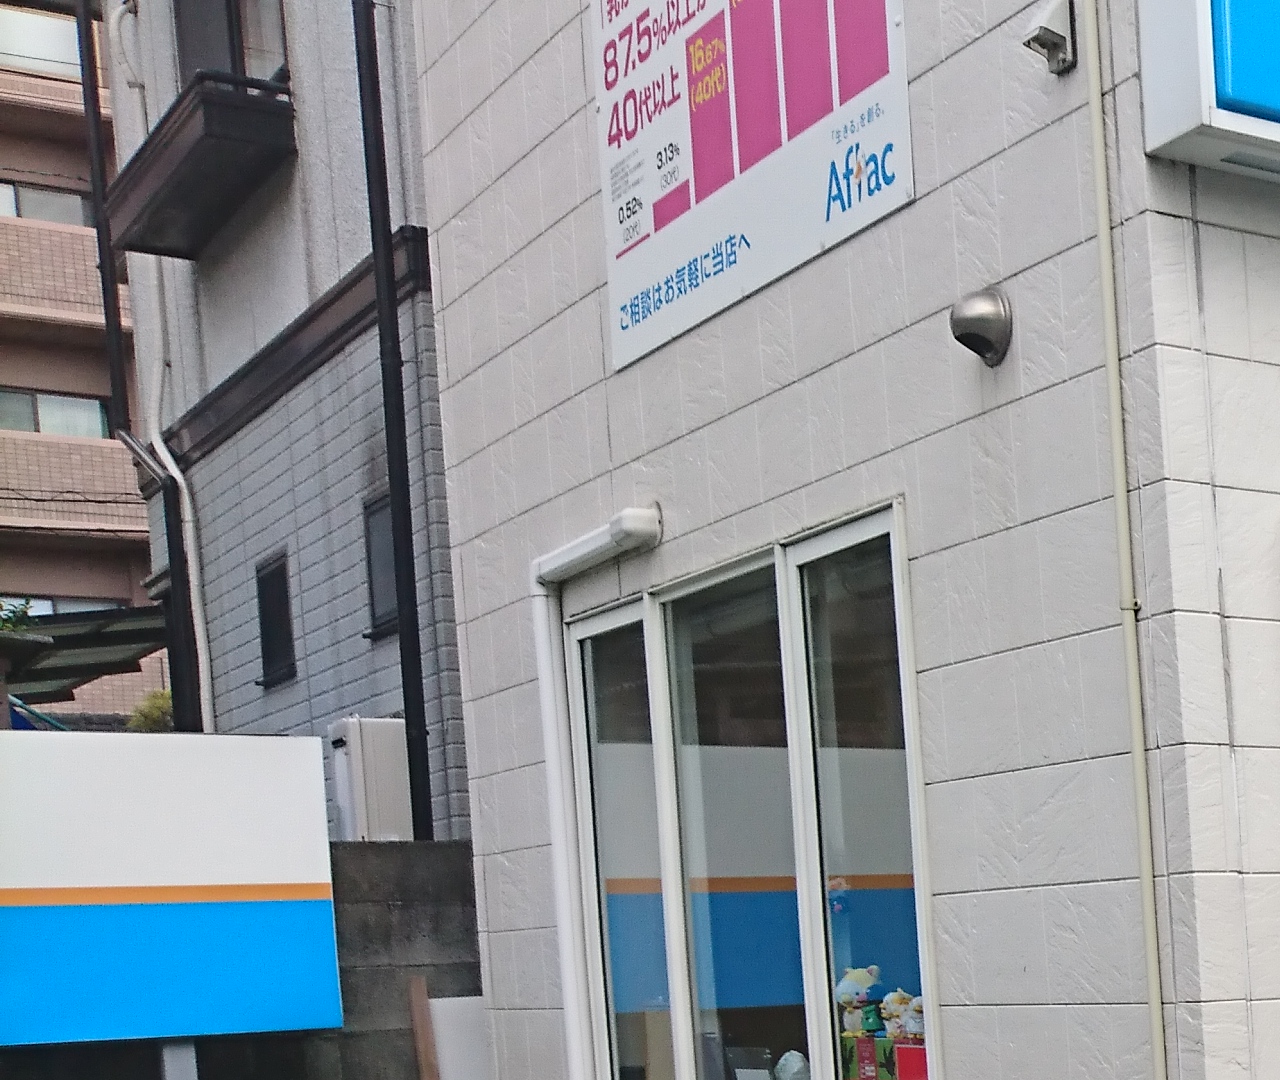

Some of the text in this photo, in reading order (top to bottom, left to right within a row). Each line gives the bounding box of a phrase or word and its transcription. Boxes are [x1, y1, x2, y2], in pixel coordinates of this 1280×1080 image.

[603, 0, 706, 91] 87.5%以上
[608, 65, 681, 149] 40代以上
[656, 142, 680, 170] 3.13%
[825, 141, 896, 222] Aflac
[618, 196, 643, 225] 0.52%
[620, 233, 751, 331] ご相談はお気軽に当店へ
